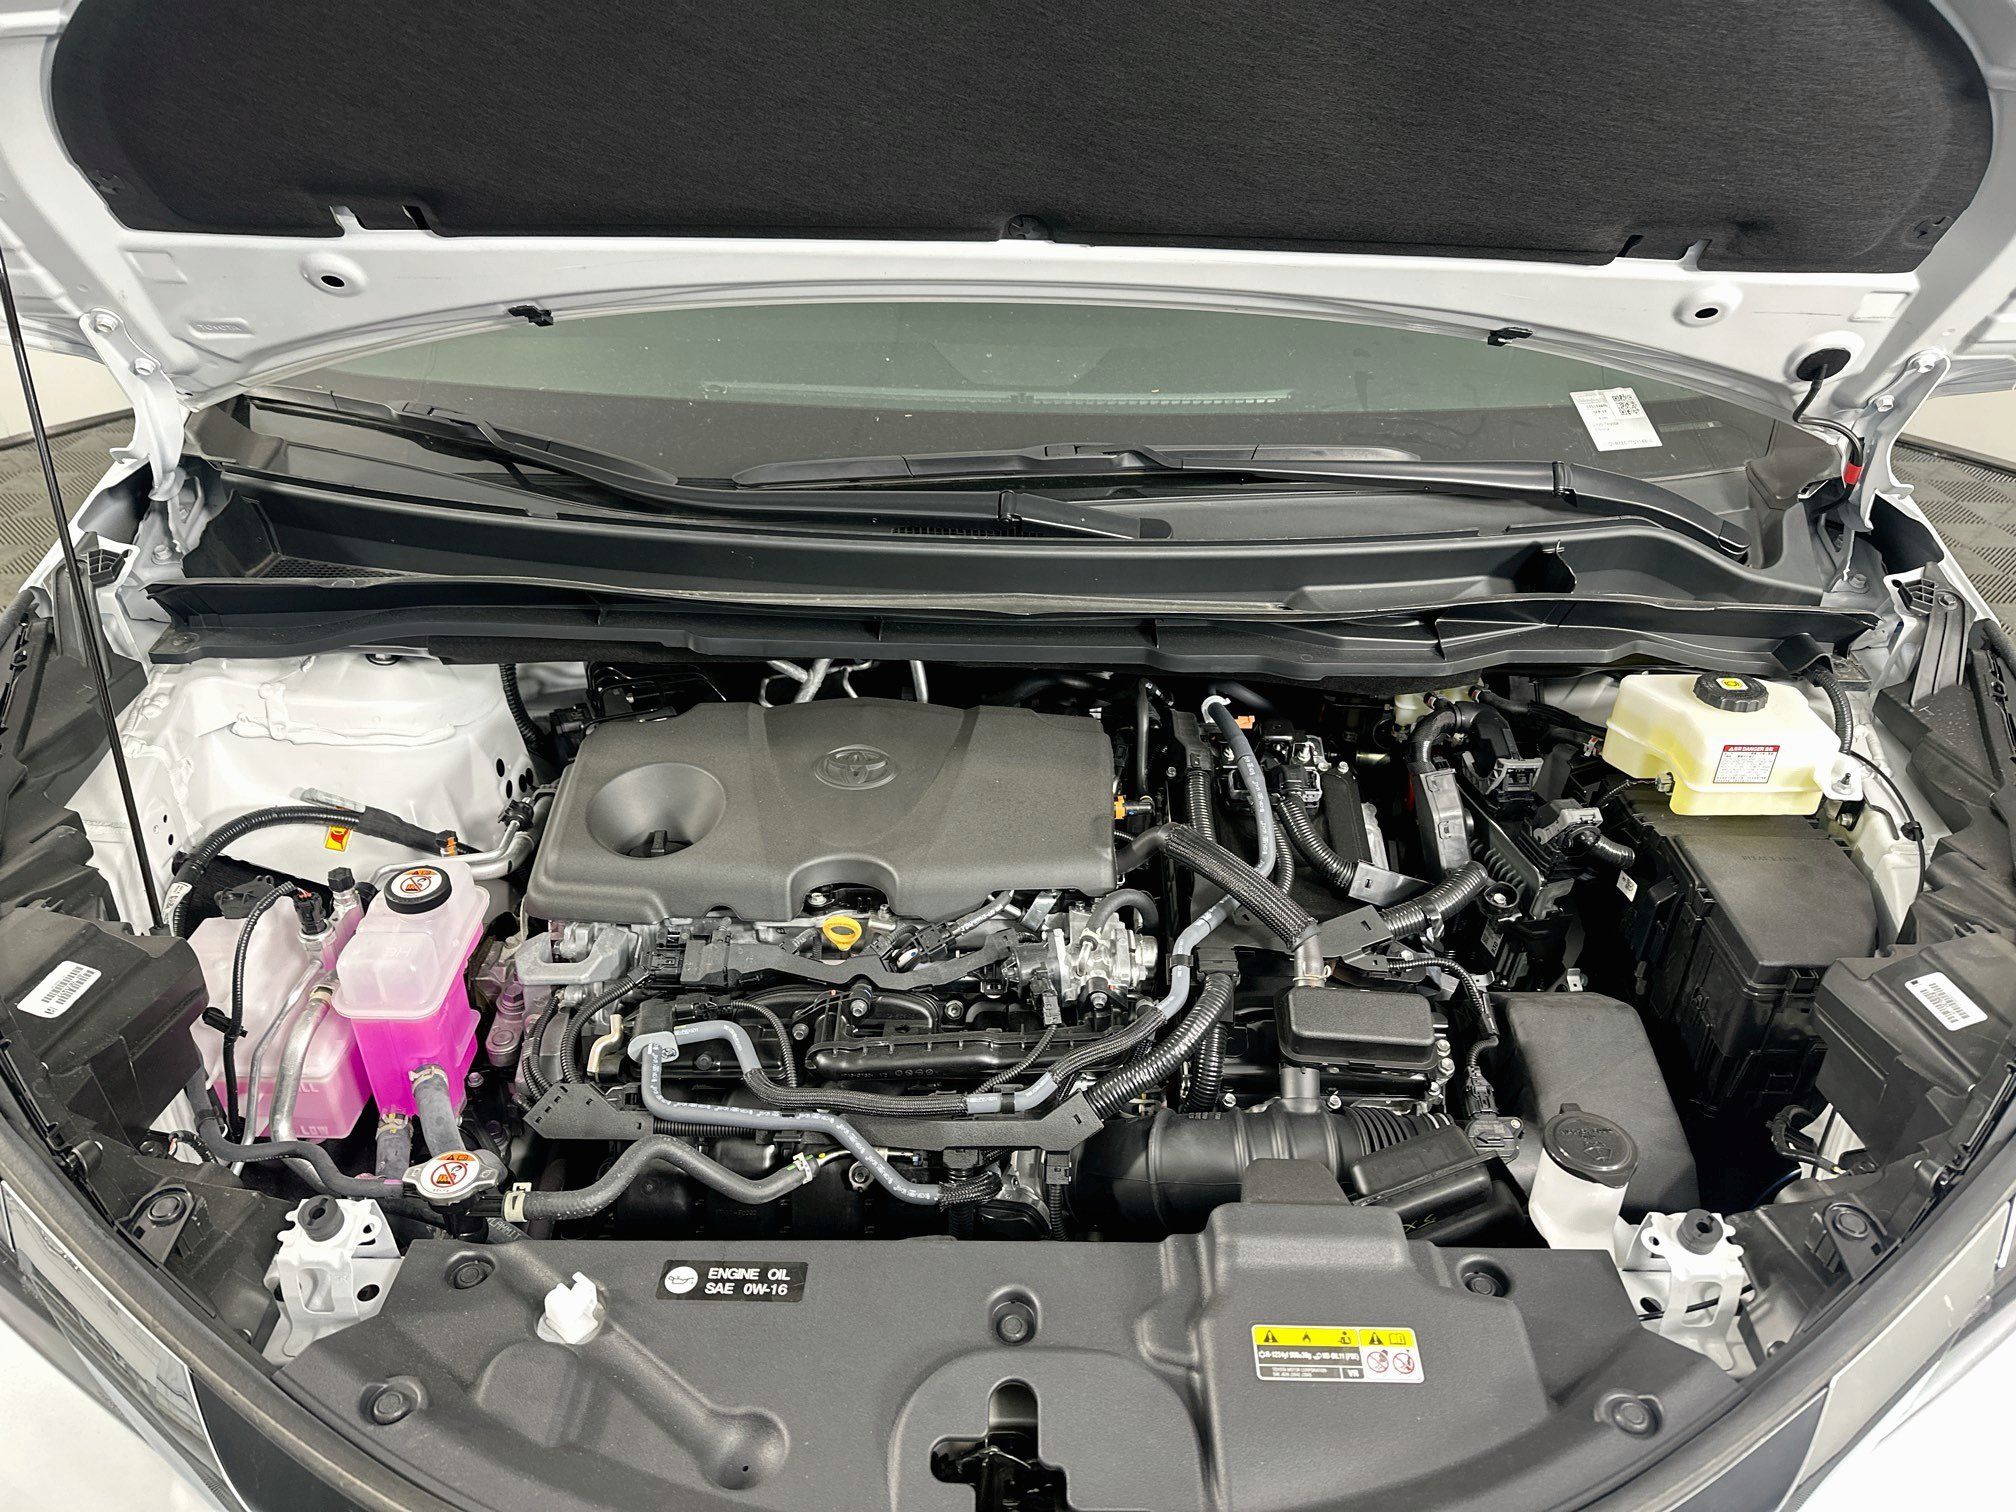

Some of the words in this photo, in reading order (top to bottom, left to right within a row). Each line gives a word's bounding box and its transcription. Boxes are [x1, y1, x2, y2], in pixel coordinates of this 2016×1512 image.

[300, 1125, 329, 1136] LOW
[707, 1268, 760, 1280] ENGINE
[767, 1268, 791, 1281] OIL
[704, 1282, 735, 1295] SAE
[743, 1283, 788, 1296] 0W-16
